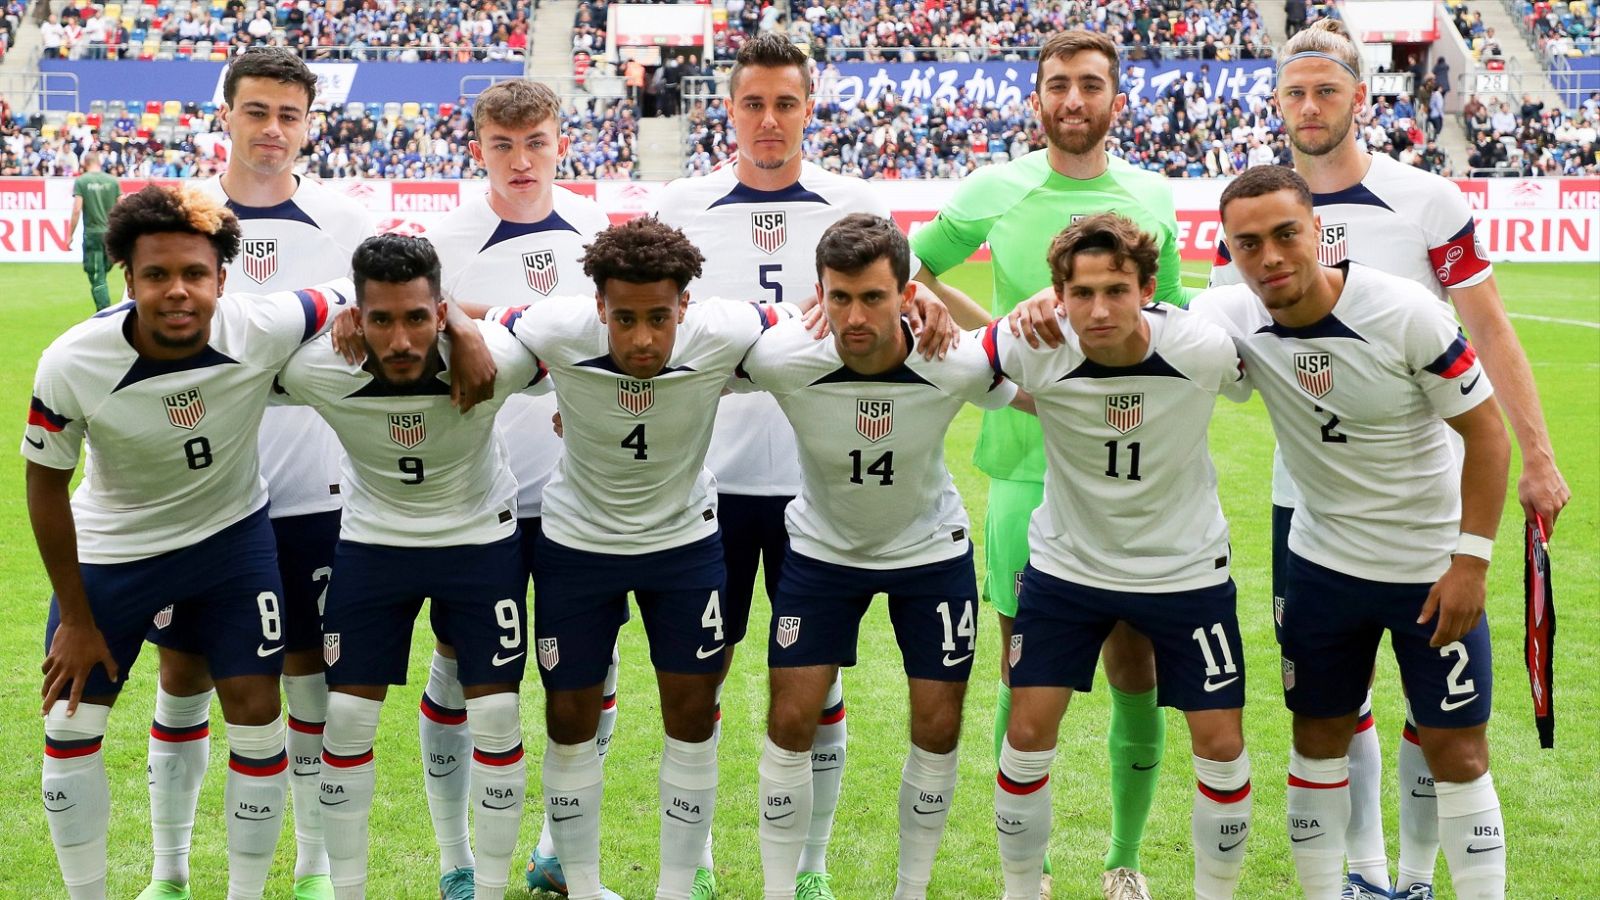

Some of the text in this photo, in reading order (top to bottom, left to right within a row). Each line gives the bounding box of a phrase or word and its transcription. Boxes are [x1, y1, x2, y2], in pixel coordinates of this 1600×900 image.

[1483, 75, 1501, 91] 28
[0, 191, 43, 209] RIN
[394, 194, 457, 211] KIRIN
[755, 214, 783, 231] USA
[1474, 219, 1590, 252] IRIN
[246, 242, 275, 258] USA
[525, 253, 553, 270] USA
[759, 264, 783, 303] 5
[1298, 355, 1330, 373] USA
[620, 381, 652, 394] USA
[166, 390, 198, 408] USA
[1109, 395, 1141, 410] USA
[860, 402, 891, 418] USA
[391, 415, 422, 429] USA
[1314, 404, 1347, 443] 2
[621, 424, 648, 460] 4
[184, 436, 213, 470] 8
[1104, 440, 1141, 481] 11
[398, 456, 425, 485] 9
[848, 449, 894, 486] 14
[257, 591, 282, 641] 8
[494, 598, 521, 649] 9
[701, 590, 725, 641] 4
[780, 618, 799, 630] USA
[936, 600, 976, 650] 14
[1192, 622, 1238, 676] 11
[1439, 641, 1475, 695] 2
[295, 756, 321, 765] USA
[430, 752, 456, 764] USA
[811, 753, 837, 762] USA
[320, 780, 345, 794] USA
[486, 787, 514, 799] USA
[551, 797, 580, 807] USA
[673, 797, 701, 815] USA
[767, 795, 792, 807] USA
[919, 791, 943, 804] USA
[240, 802, 271, 813] USA
[1220, 822, 1247, 835] USA
[1292, 819, 1320, 829] USA
[1474, 826, 1500, 837] USA
